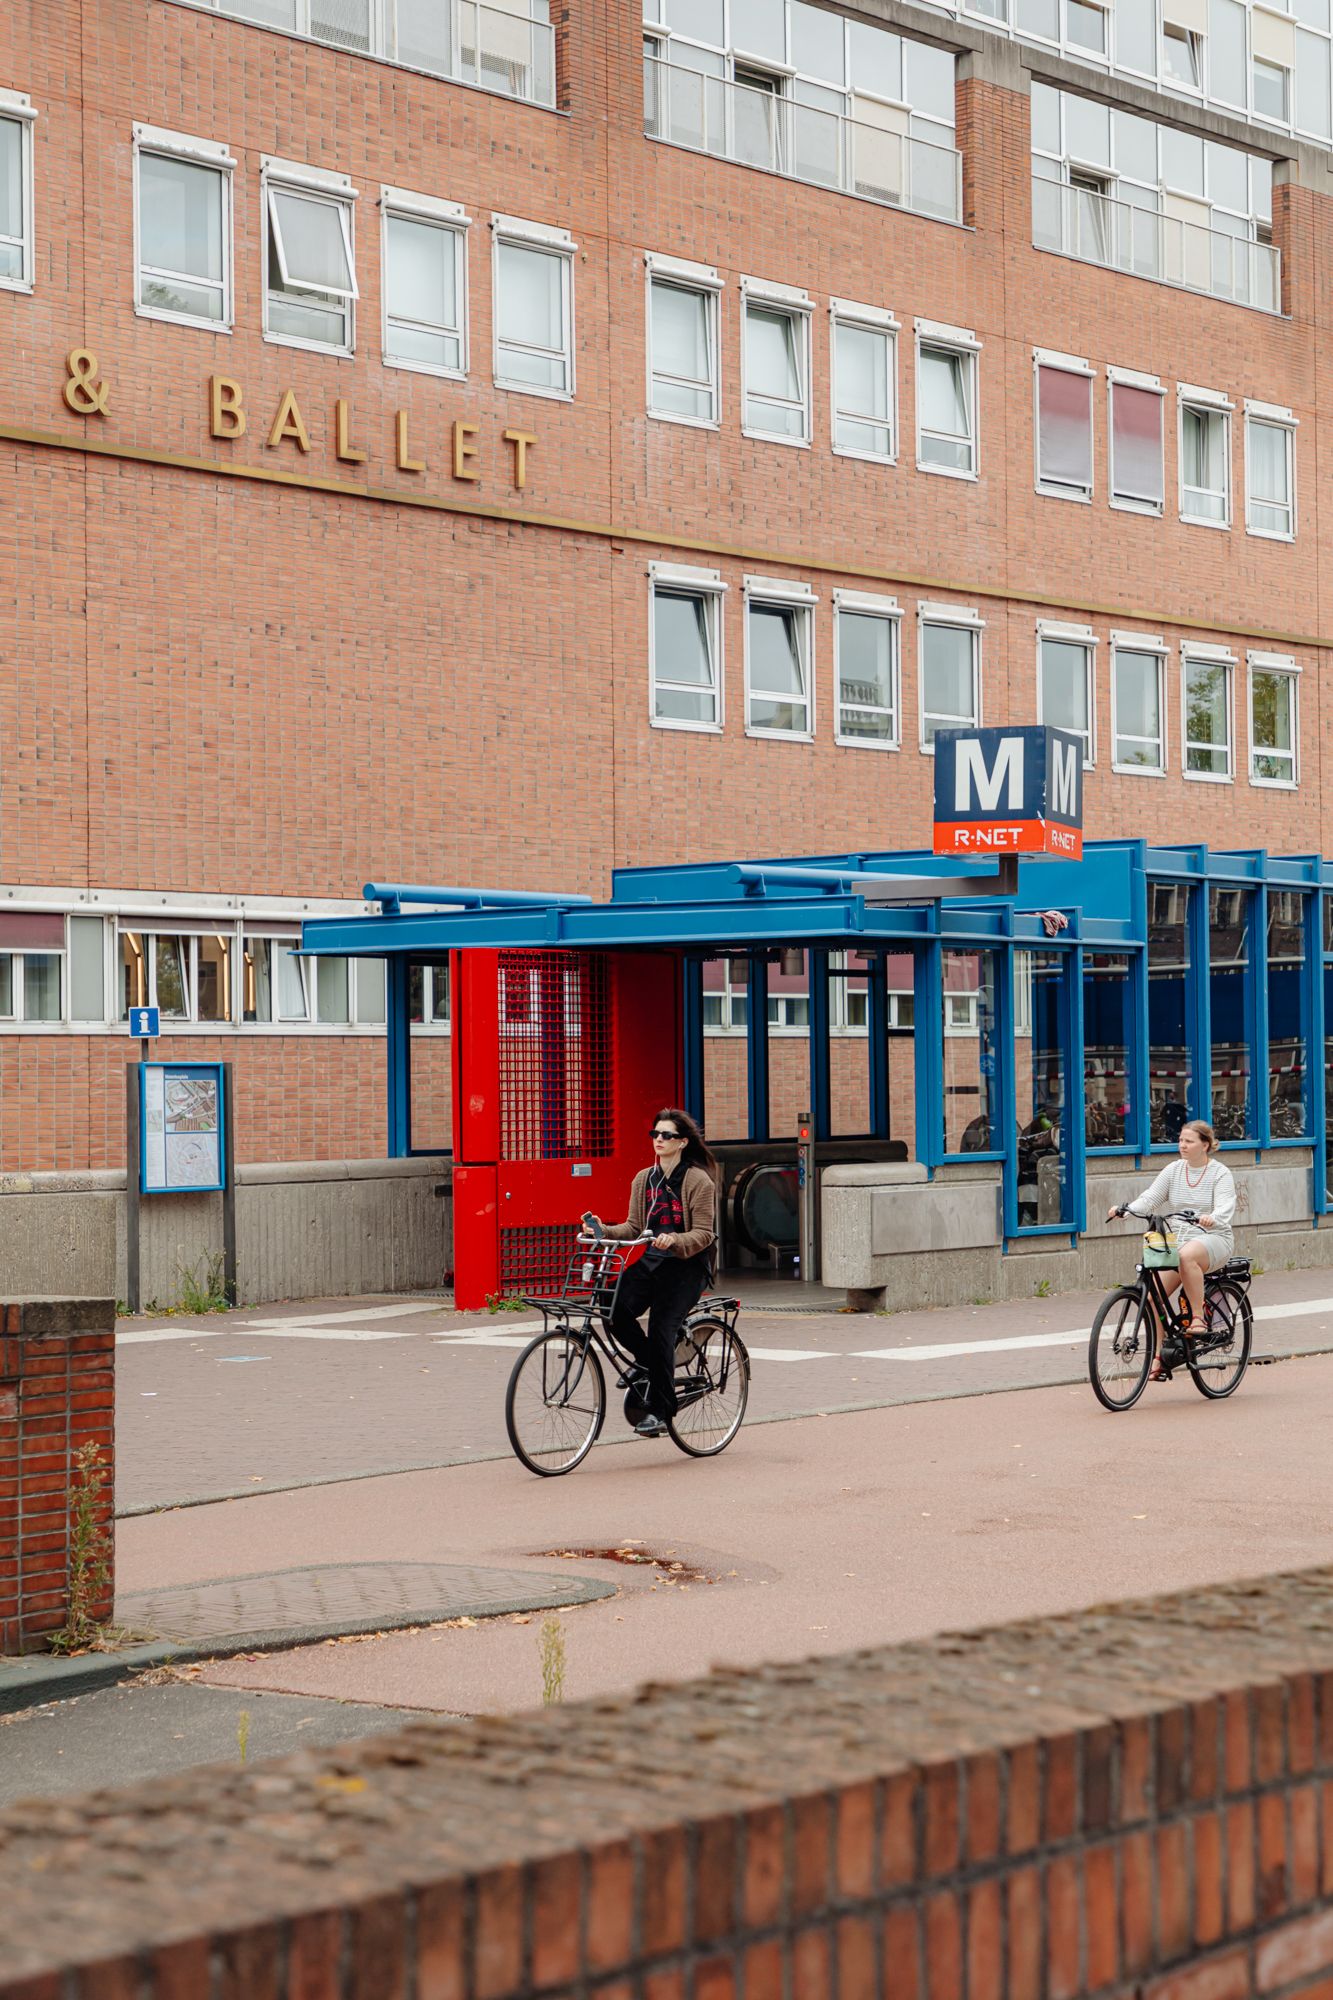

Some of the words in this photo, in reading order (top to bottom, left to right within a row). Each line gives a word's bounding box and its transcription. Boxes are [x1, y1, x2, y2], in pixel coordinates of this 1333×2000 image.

[64, 348, 112, 417] &
[209, 375, 539, 489] BALLET
[954, 737, 1024, 812] M
[1052, 739, 1077, 817] M
